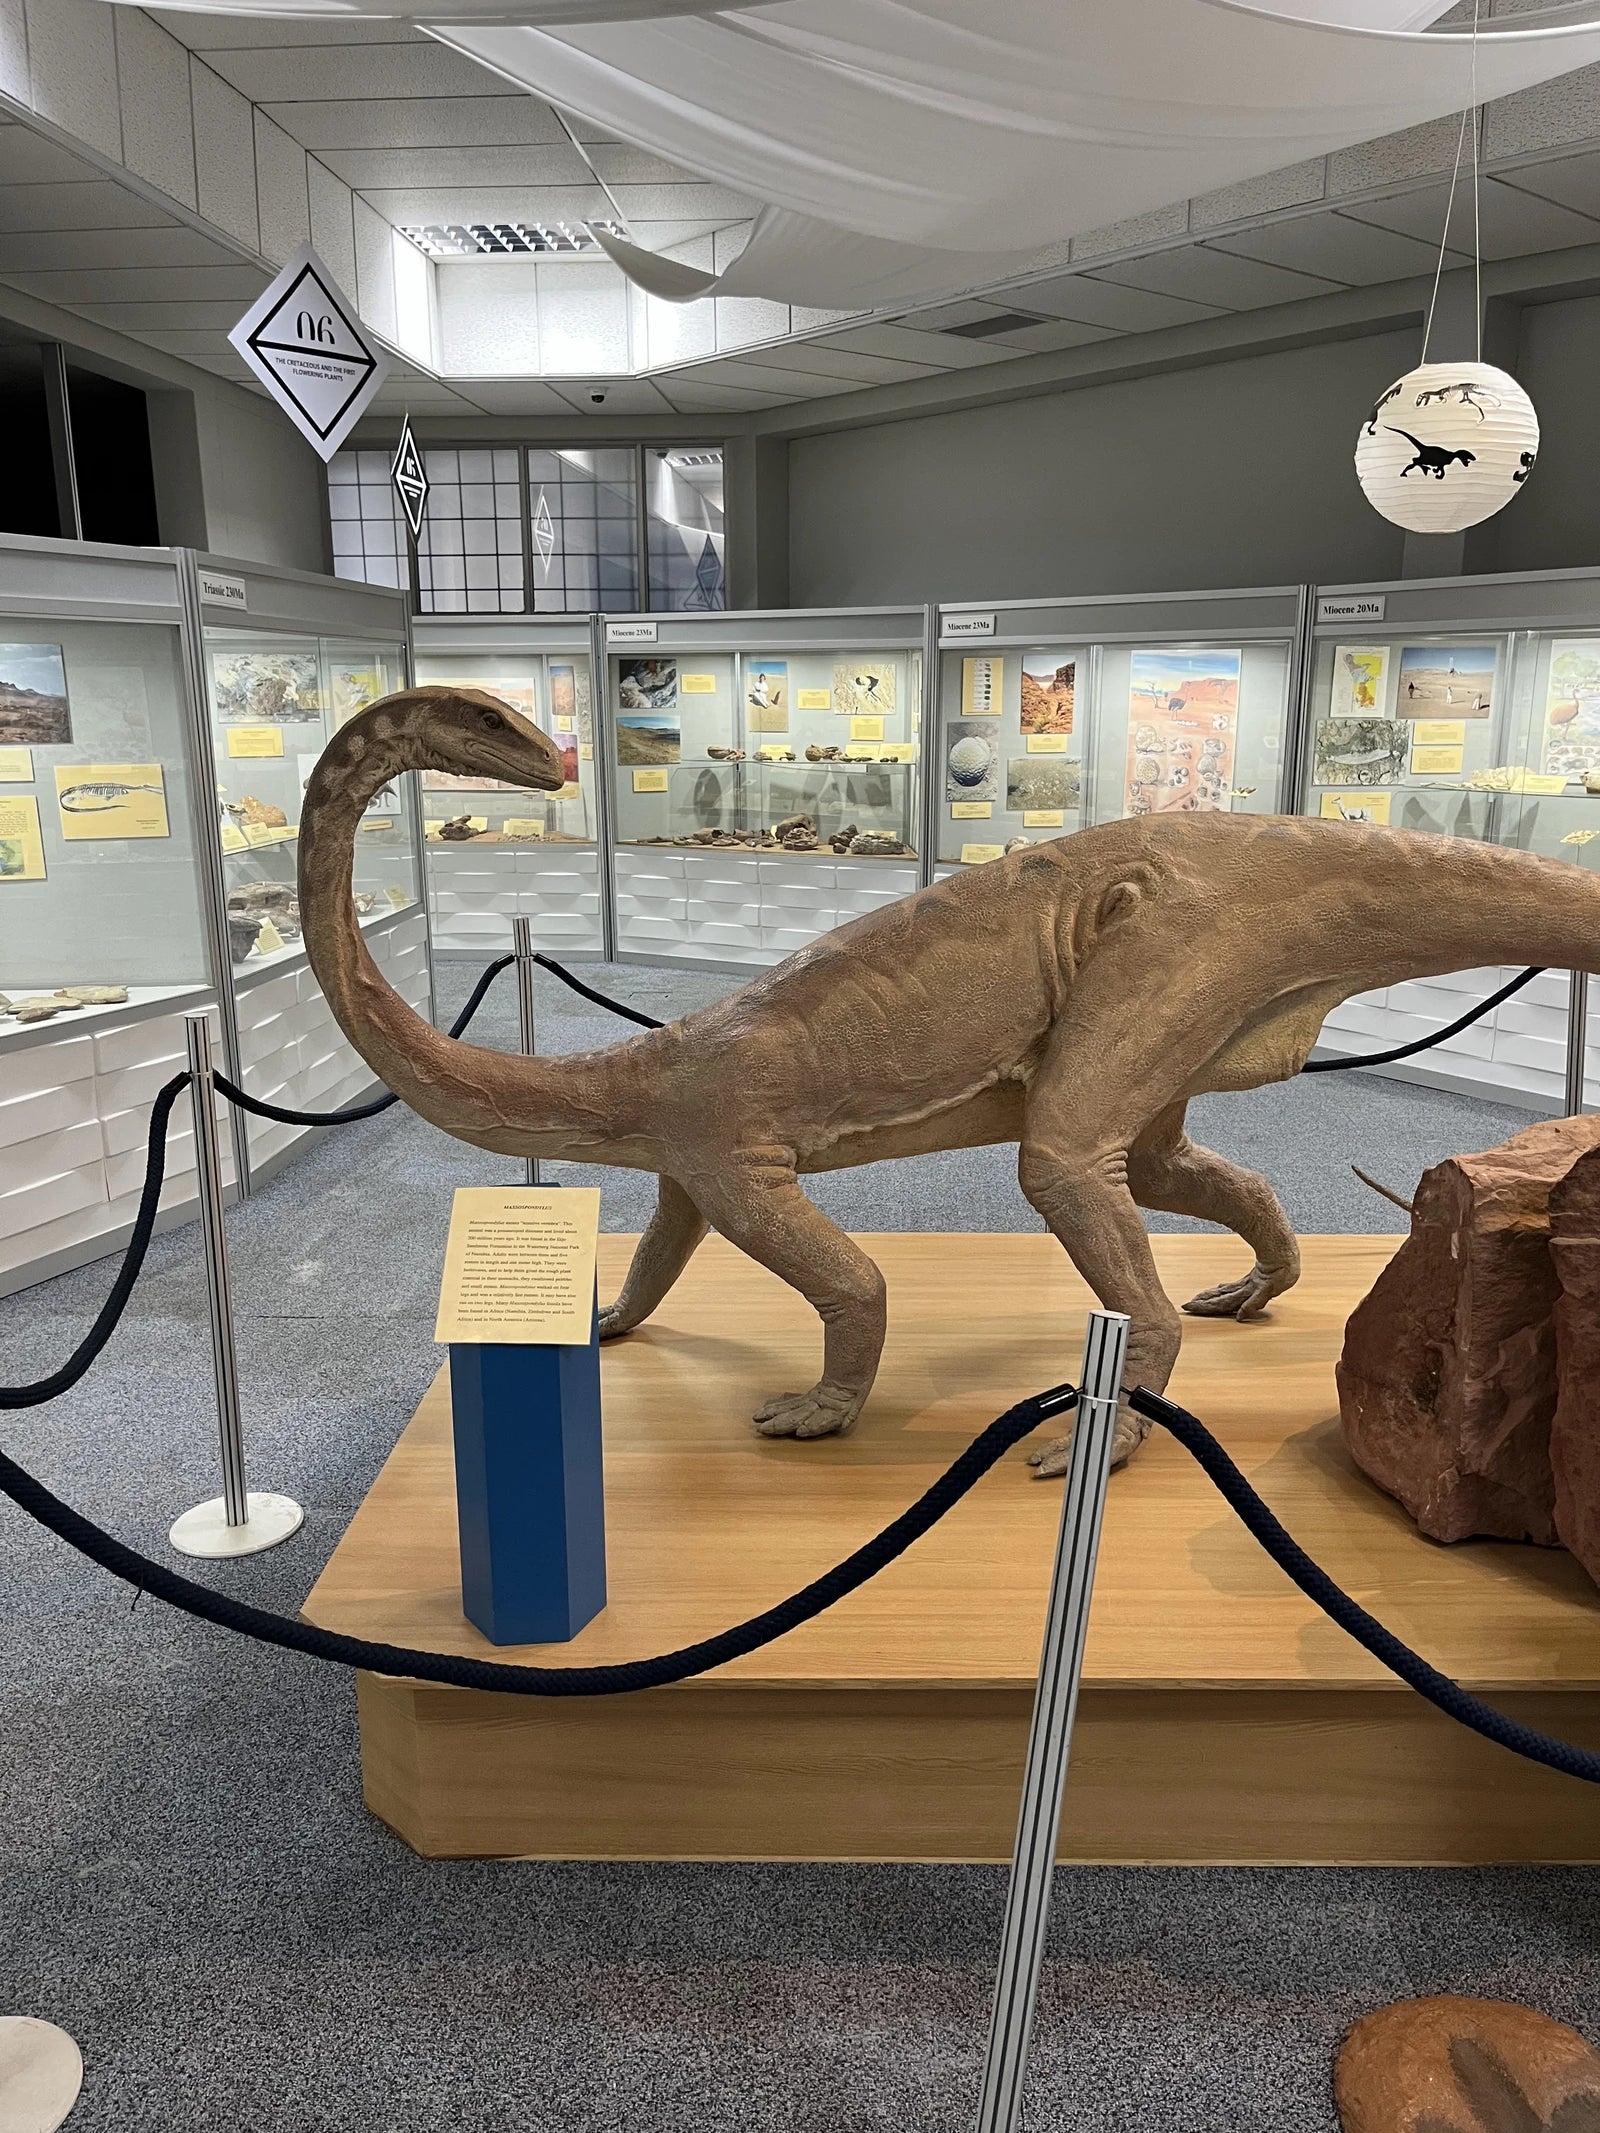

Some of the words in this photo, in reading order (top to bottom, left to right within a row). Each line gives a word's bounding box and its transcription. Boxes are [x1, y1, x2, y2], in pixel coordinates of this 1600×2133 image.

[287, 359, 320, 370] CRETACEOUS
[343, 368, 356, 376] FIRST
[293, 369, 323, 379] FLOWERING
[324, 374, 343, 382] PLANTS
[203, 582, 225, 596] Triassic
[1323, 605, 1355, 615] Miocene
[1357, 604, 1379, 613] 20Ma
[973, 622, 990, 630] 23Ma
